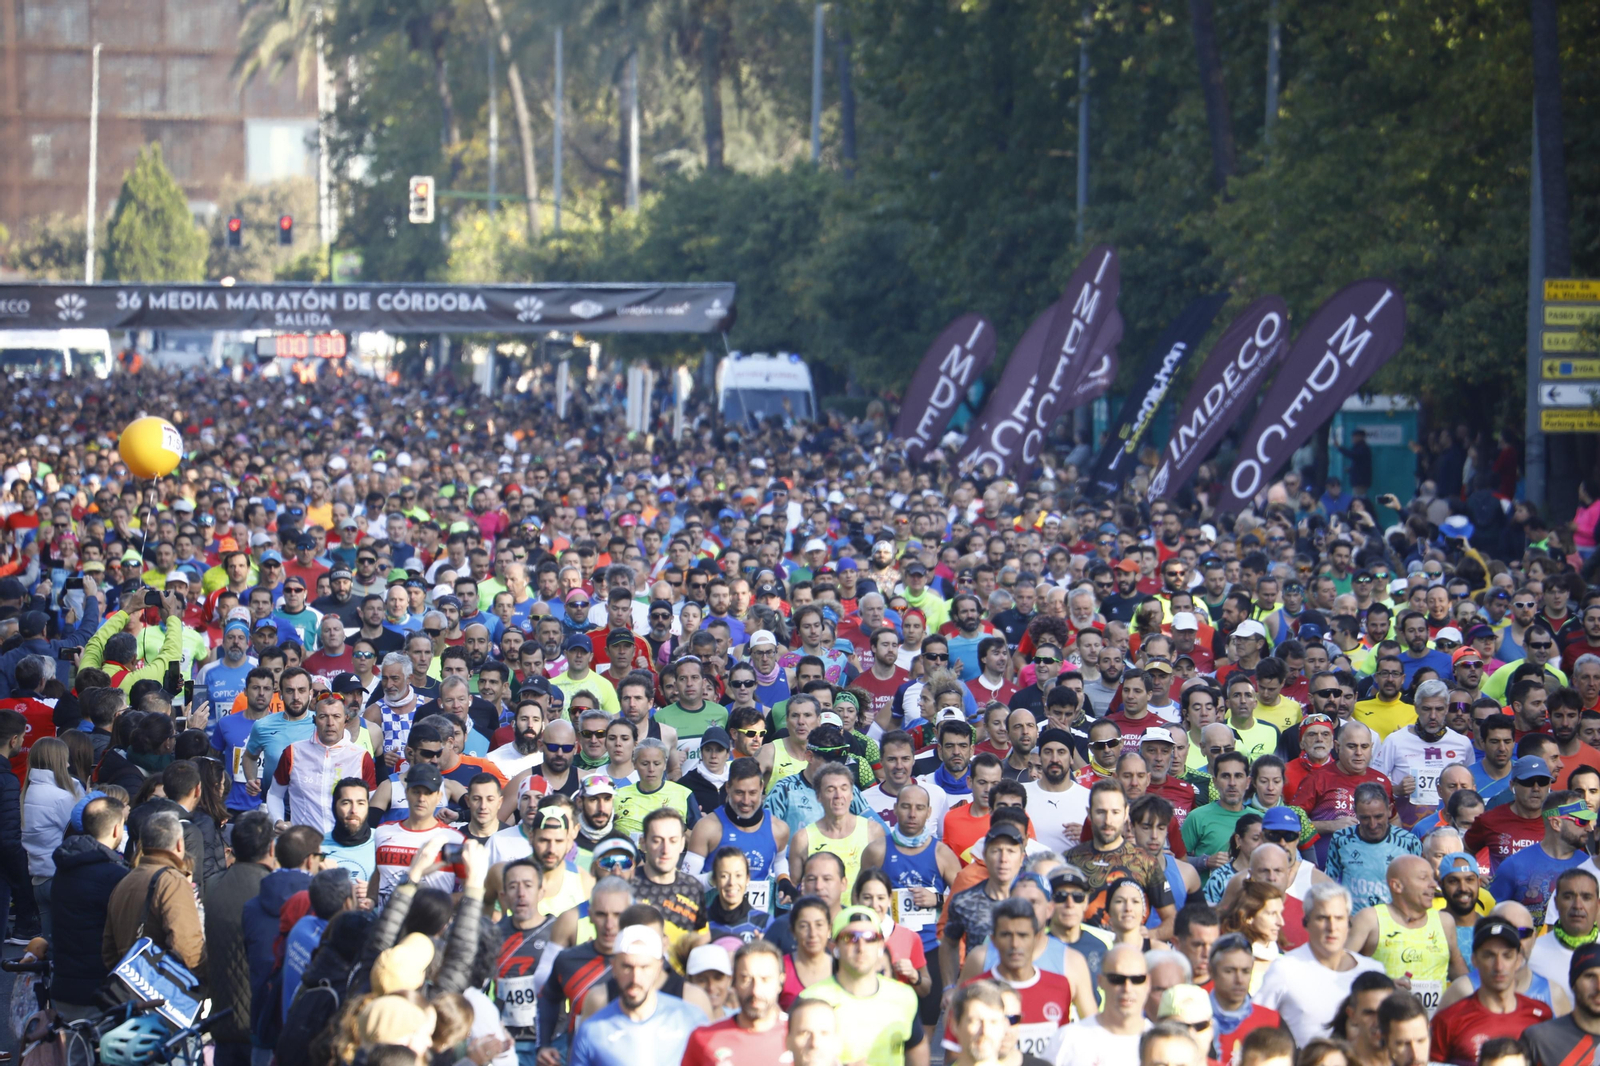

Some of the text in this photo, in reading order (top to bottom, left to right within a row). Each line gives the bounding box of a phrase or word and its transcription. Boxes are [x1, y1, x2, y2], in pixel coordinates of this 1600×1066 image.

[116, 288, 487, 312] 36 MEDIA MARATÓN DE CÓRDOBA
[274, 312, 333, 327] SALIDA
[1170, 311, 1282, 463] IMDECO
[1230, 364, 1261, 399] Deportes
[1231, 288, 1394, 500] IMDECO
[1334, 800, 1347, 810] 36
[1498, 845, 1510, 855] 36
[506, 988, 535, 1005] 489
